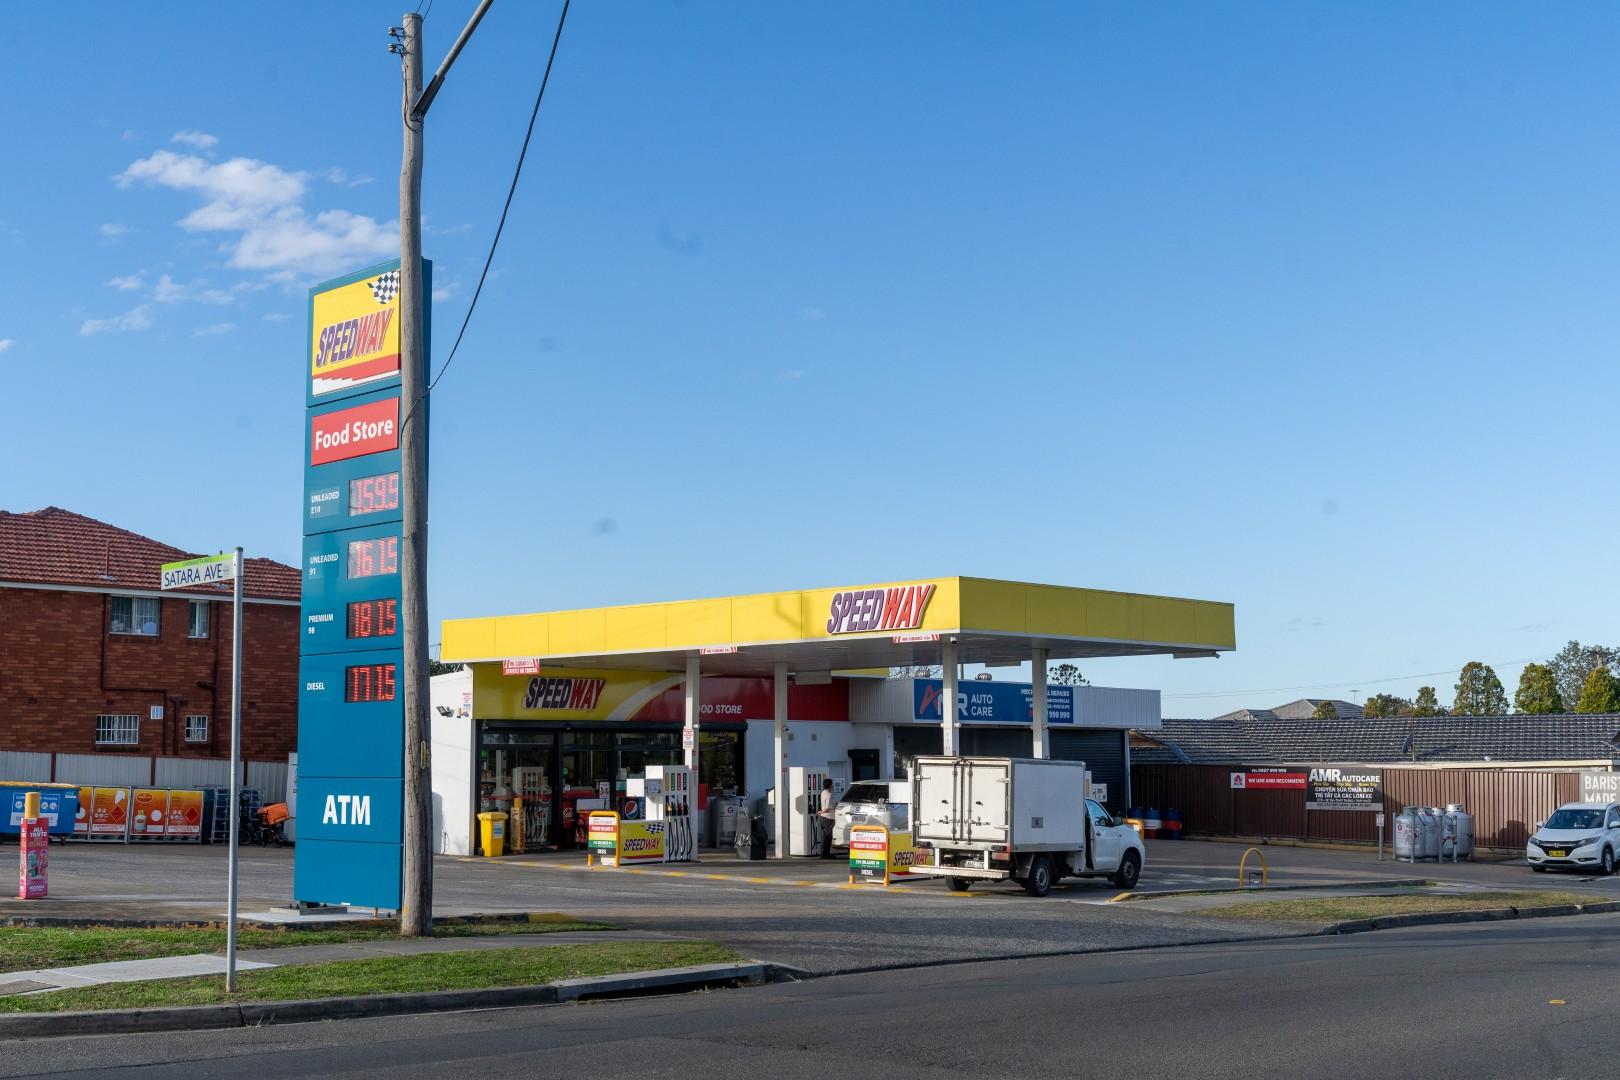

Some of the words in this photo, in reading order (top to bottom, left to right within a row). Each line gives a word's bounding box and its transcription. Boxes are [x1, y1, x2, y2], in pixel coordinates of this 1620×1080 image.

[315, 308, 394, 368] SPEEDWAY
[315, 422, 350, 450] Food
[352, 418, 393, 442] Store
[311, 491, 340, 503] UNLEADED
[311, 506, 321, 515] E10
[310, 553, 339, 564] UNLEADED
[164, 567, 200, 587] SATARA
[204, 563, 223, 581] AVE
[309, 567, 316, 577] 91
[826, 584, 932, 634] SPEEDWAY
[308, 613, 334, 624] PREMIUM
[306, 682, 325, 691] DIESEL
[525, 677, 606, 710] SPEEDWAY
[971, 694, 993, 704] AUTO
[715, 704, 742, 714] STORE
[971, 707, 993, 716] CARE
[1309, 768, 1341, 782] AMR
[323, 795, 371, 826] ATM
[624, 837, 661, 852] SPEEDWAY
[893, 850, 929, 866] SPEEDWAY
